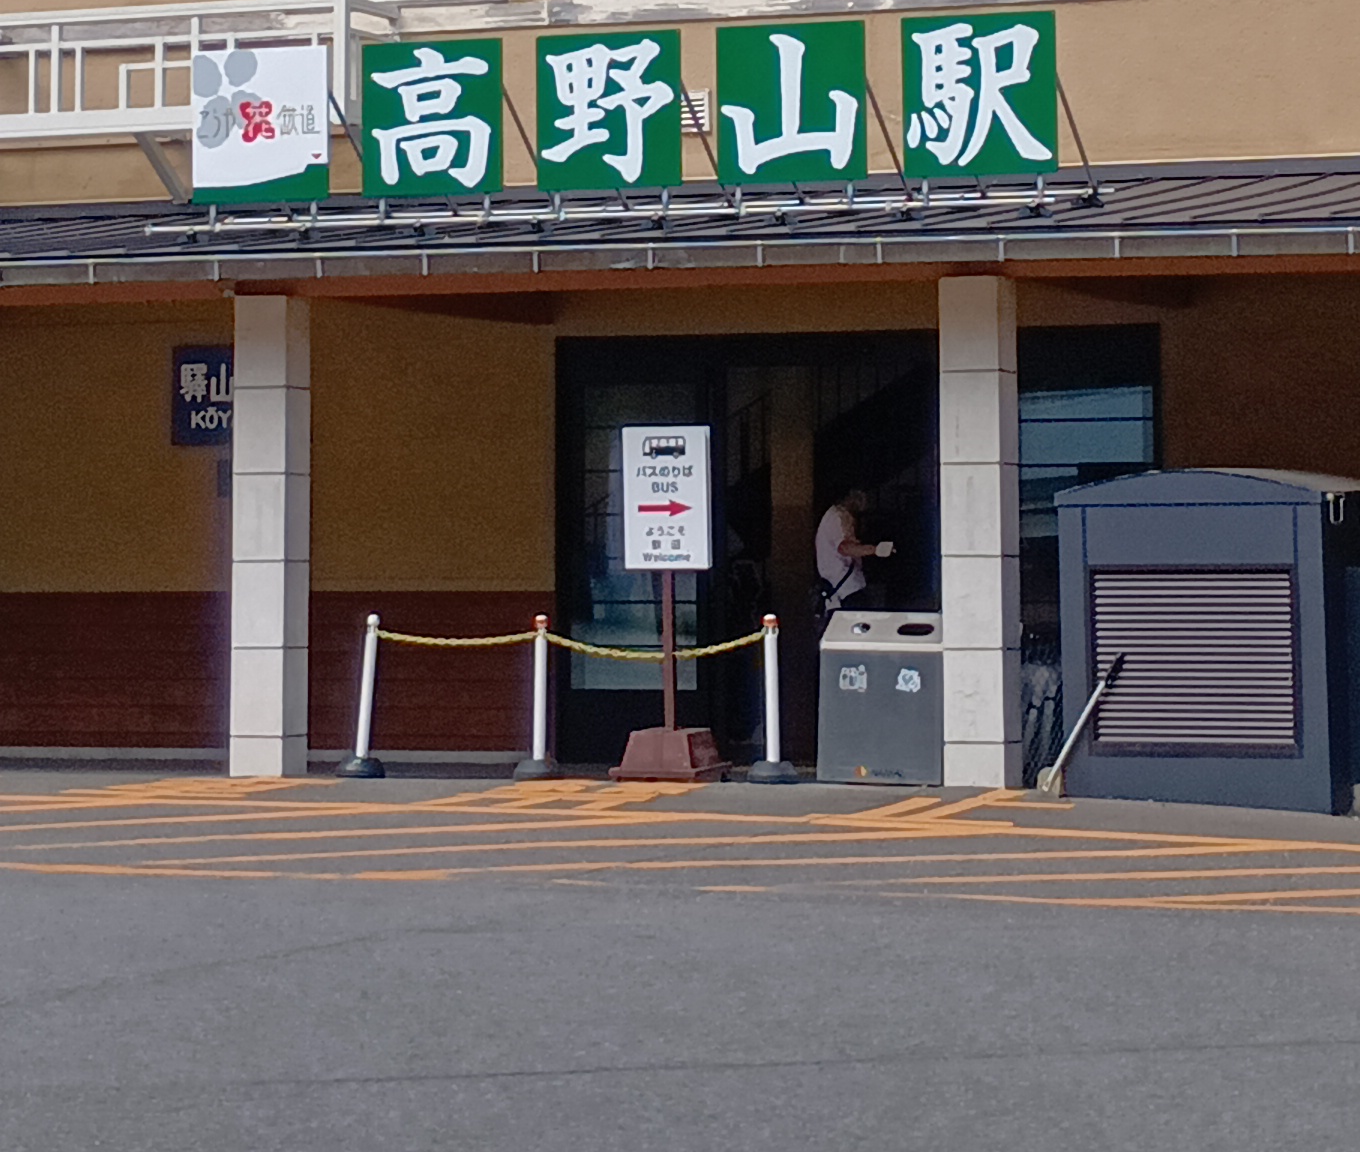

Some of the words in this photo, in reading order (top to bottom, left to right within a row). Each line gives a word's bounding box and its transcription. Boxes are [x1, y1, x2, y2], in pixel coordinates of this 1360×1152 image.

[370, 22, 1053, 189] 高野山駅
[190, 406, 234, 429] KŌY
[636, 465, 694, 478] バスのりば
[651, 481, 679, 494] BUS
[645, 525, 686, 537] ようこそ
[642, 552, 691, 563] Welcome
